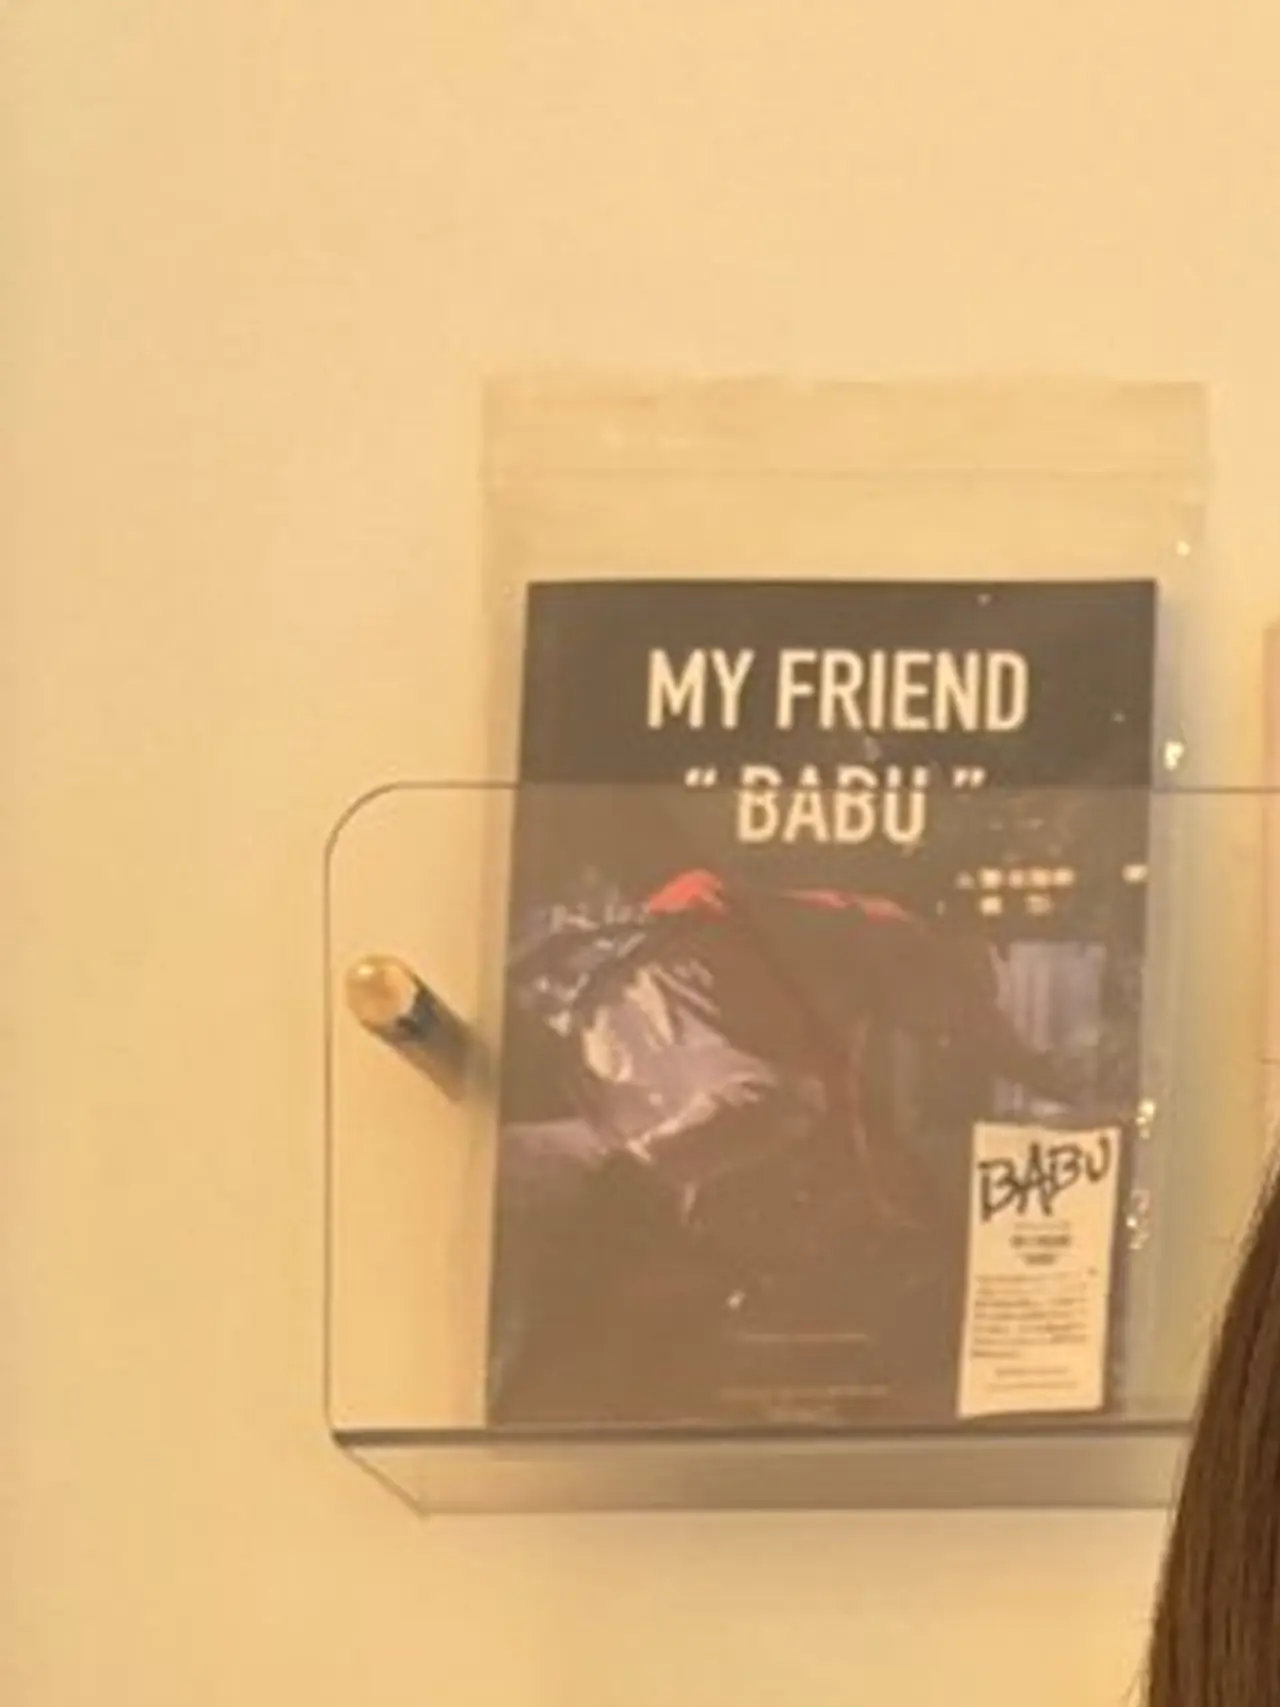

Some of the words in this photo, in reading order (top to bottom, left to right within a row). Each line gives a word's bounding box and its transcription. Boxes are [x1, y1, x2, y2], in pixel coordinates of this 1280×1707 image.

[646, 647, 755, 731] MY
[775, 647, 1030, 732] FRIEND
[976, 1136, 1112, 1222] BABU
